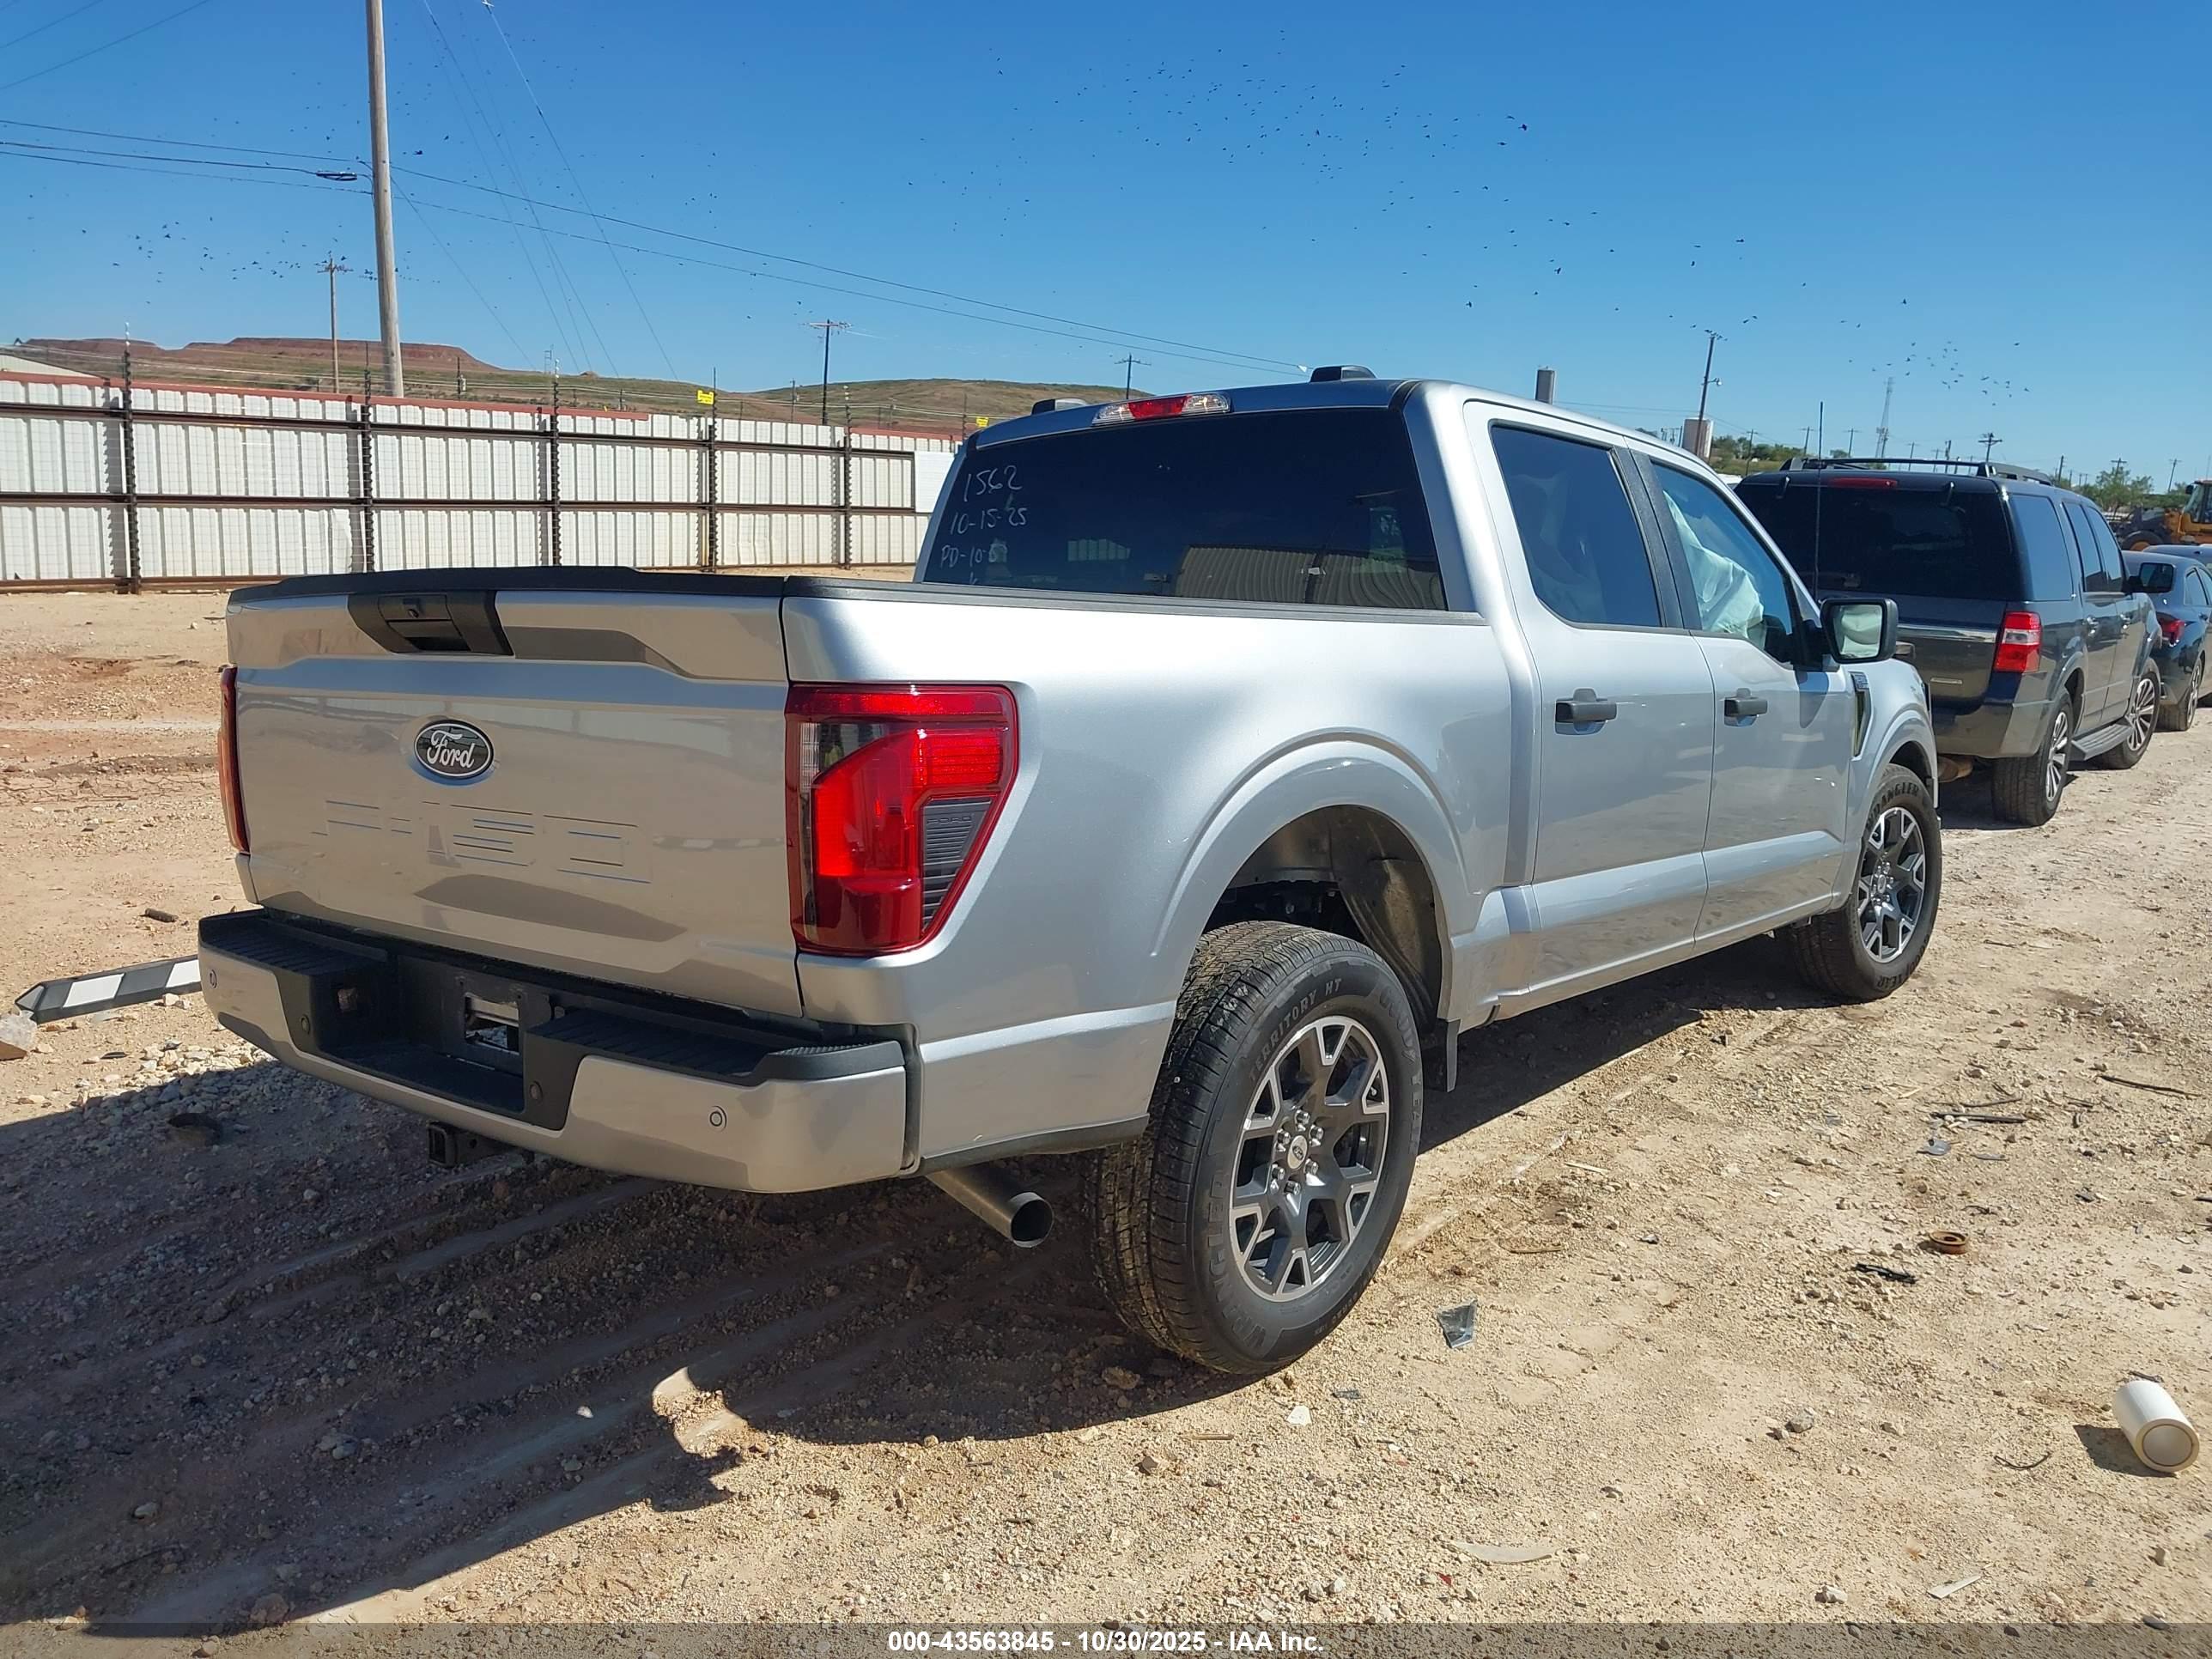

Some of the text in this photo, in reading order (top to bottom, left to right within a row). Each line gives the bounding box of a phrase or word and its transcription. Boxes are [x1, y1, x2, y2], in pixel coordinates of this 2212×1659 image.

[963, 465, 1024, 502] 1562
[950, 507, 1028, 535] 10-15-25
[427, 730, 476, 769] Ford
[1249, 988, 1317, 1083] TERRITORY
[1325, 977, 1342, 997] HT
